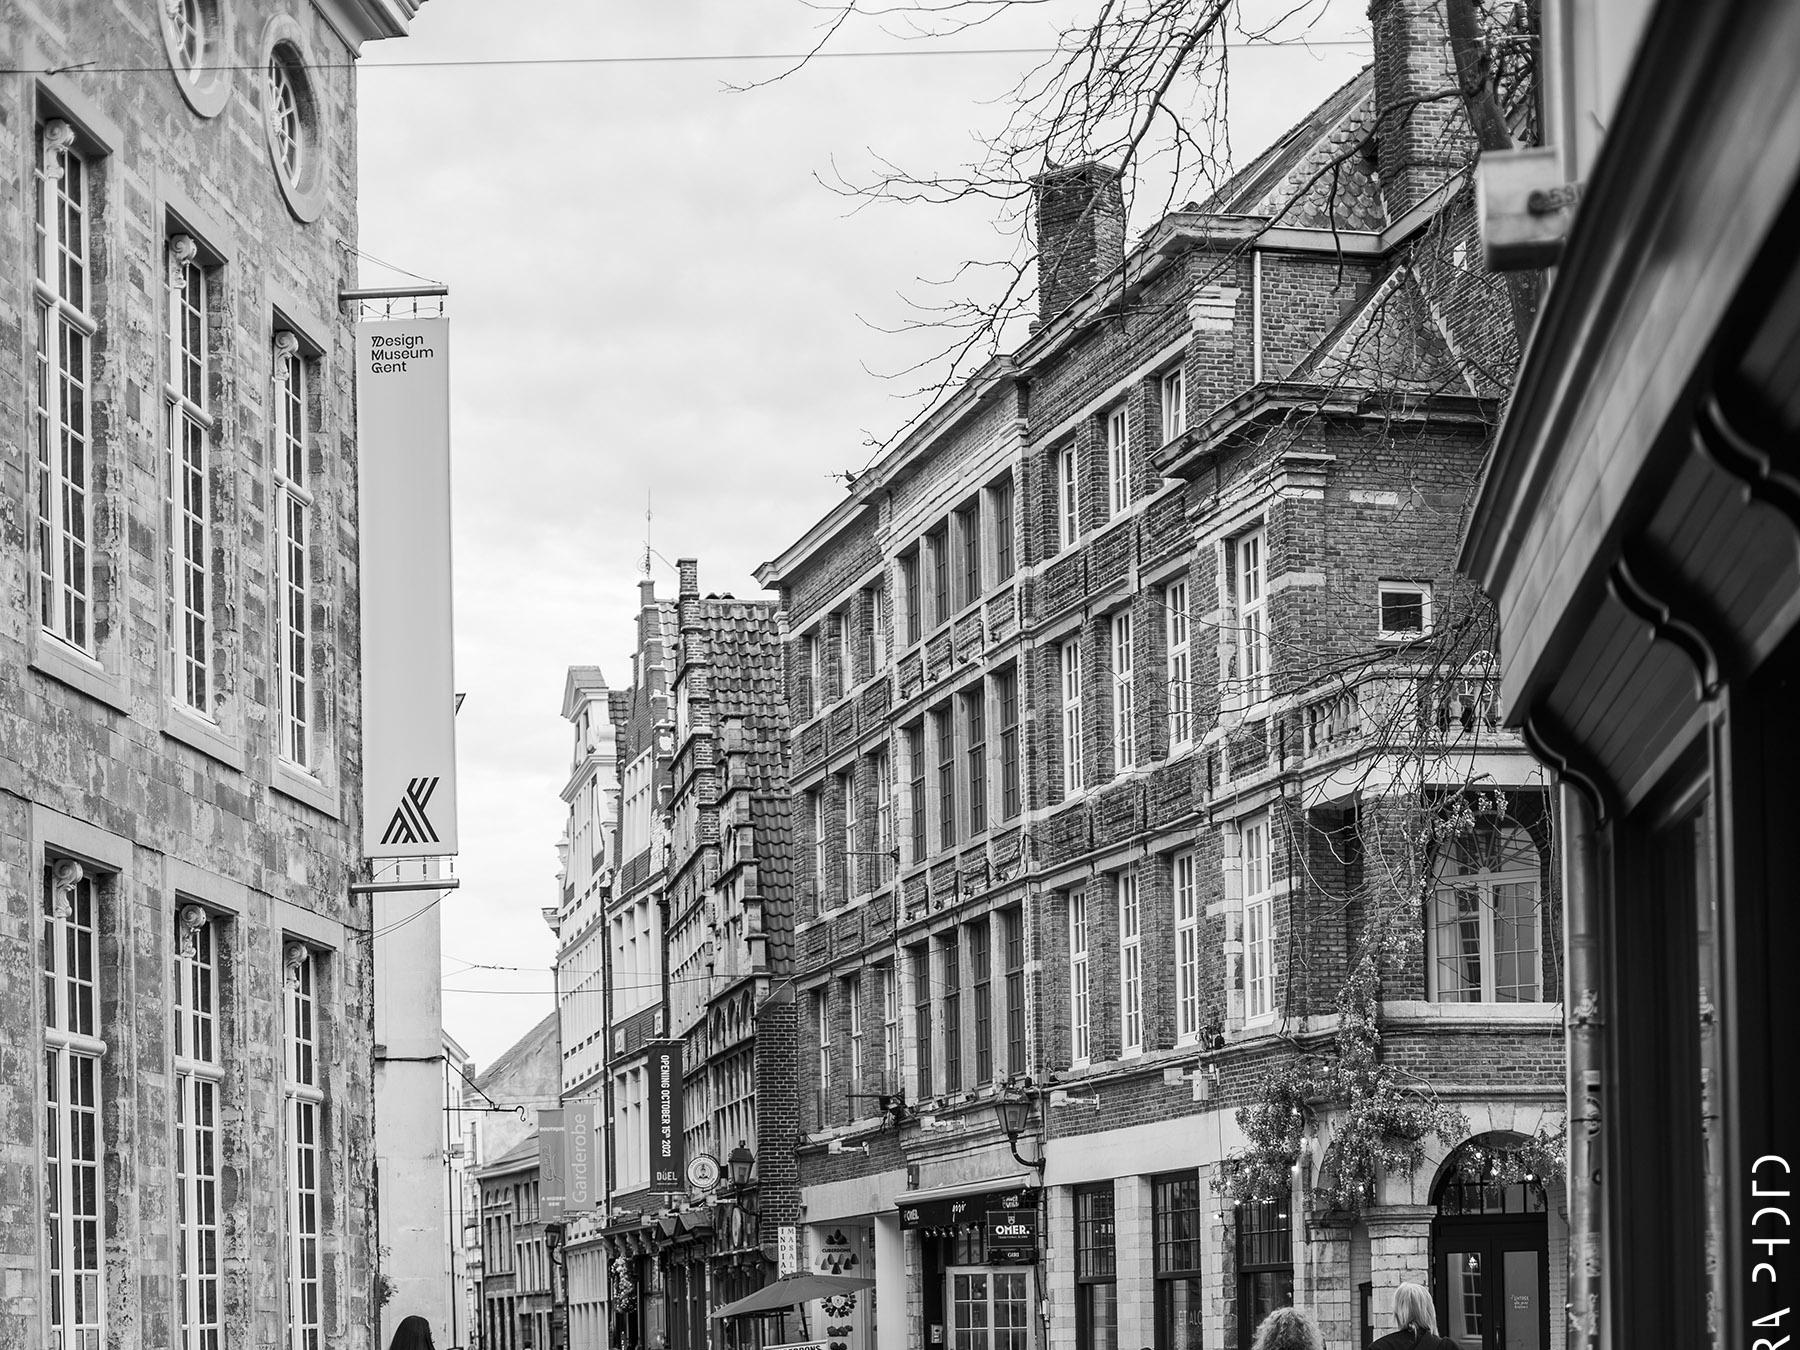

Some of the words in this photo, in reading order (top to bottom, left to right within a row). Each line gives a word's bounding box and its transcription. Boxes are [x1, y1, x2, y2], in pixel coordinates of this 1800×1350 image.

[371, 334, 424, 349] Design
[371, 348, 434, 361] Museum
[371, 361, 407, 374] Gent
[660, 1054, 670, 1088] OPENING
[661, 1089, 671, 1124] OCTOBER
[662, 1139, 671, 1157] 2021
[571, 1113, 587, 1203] Garderobe
[995, 1224, 1030, 1235] OMER.
[787, 1228, 795, 1274] MASAL
